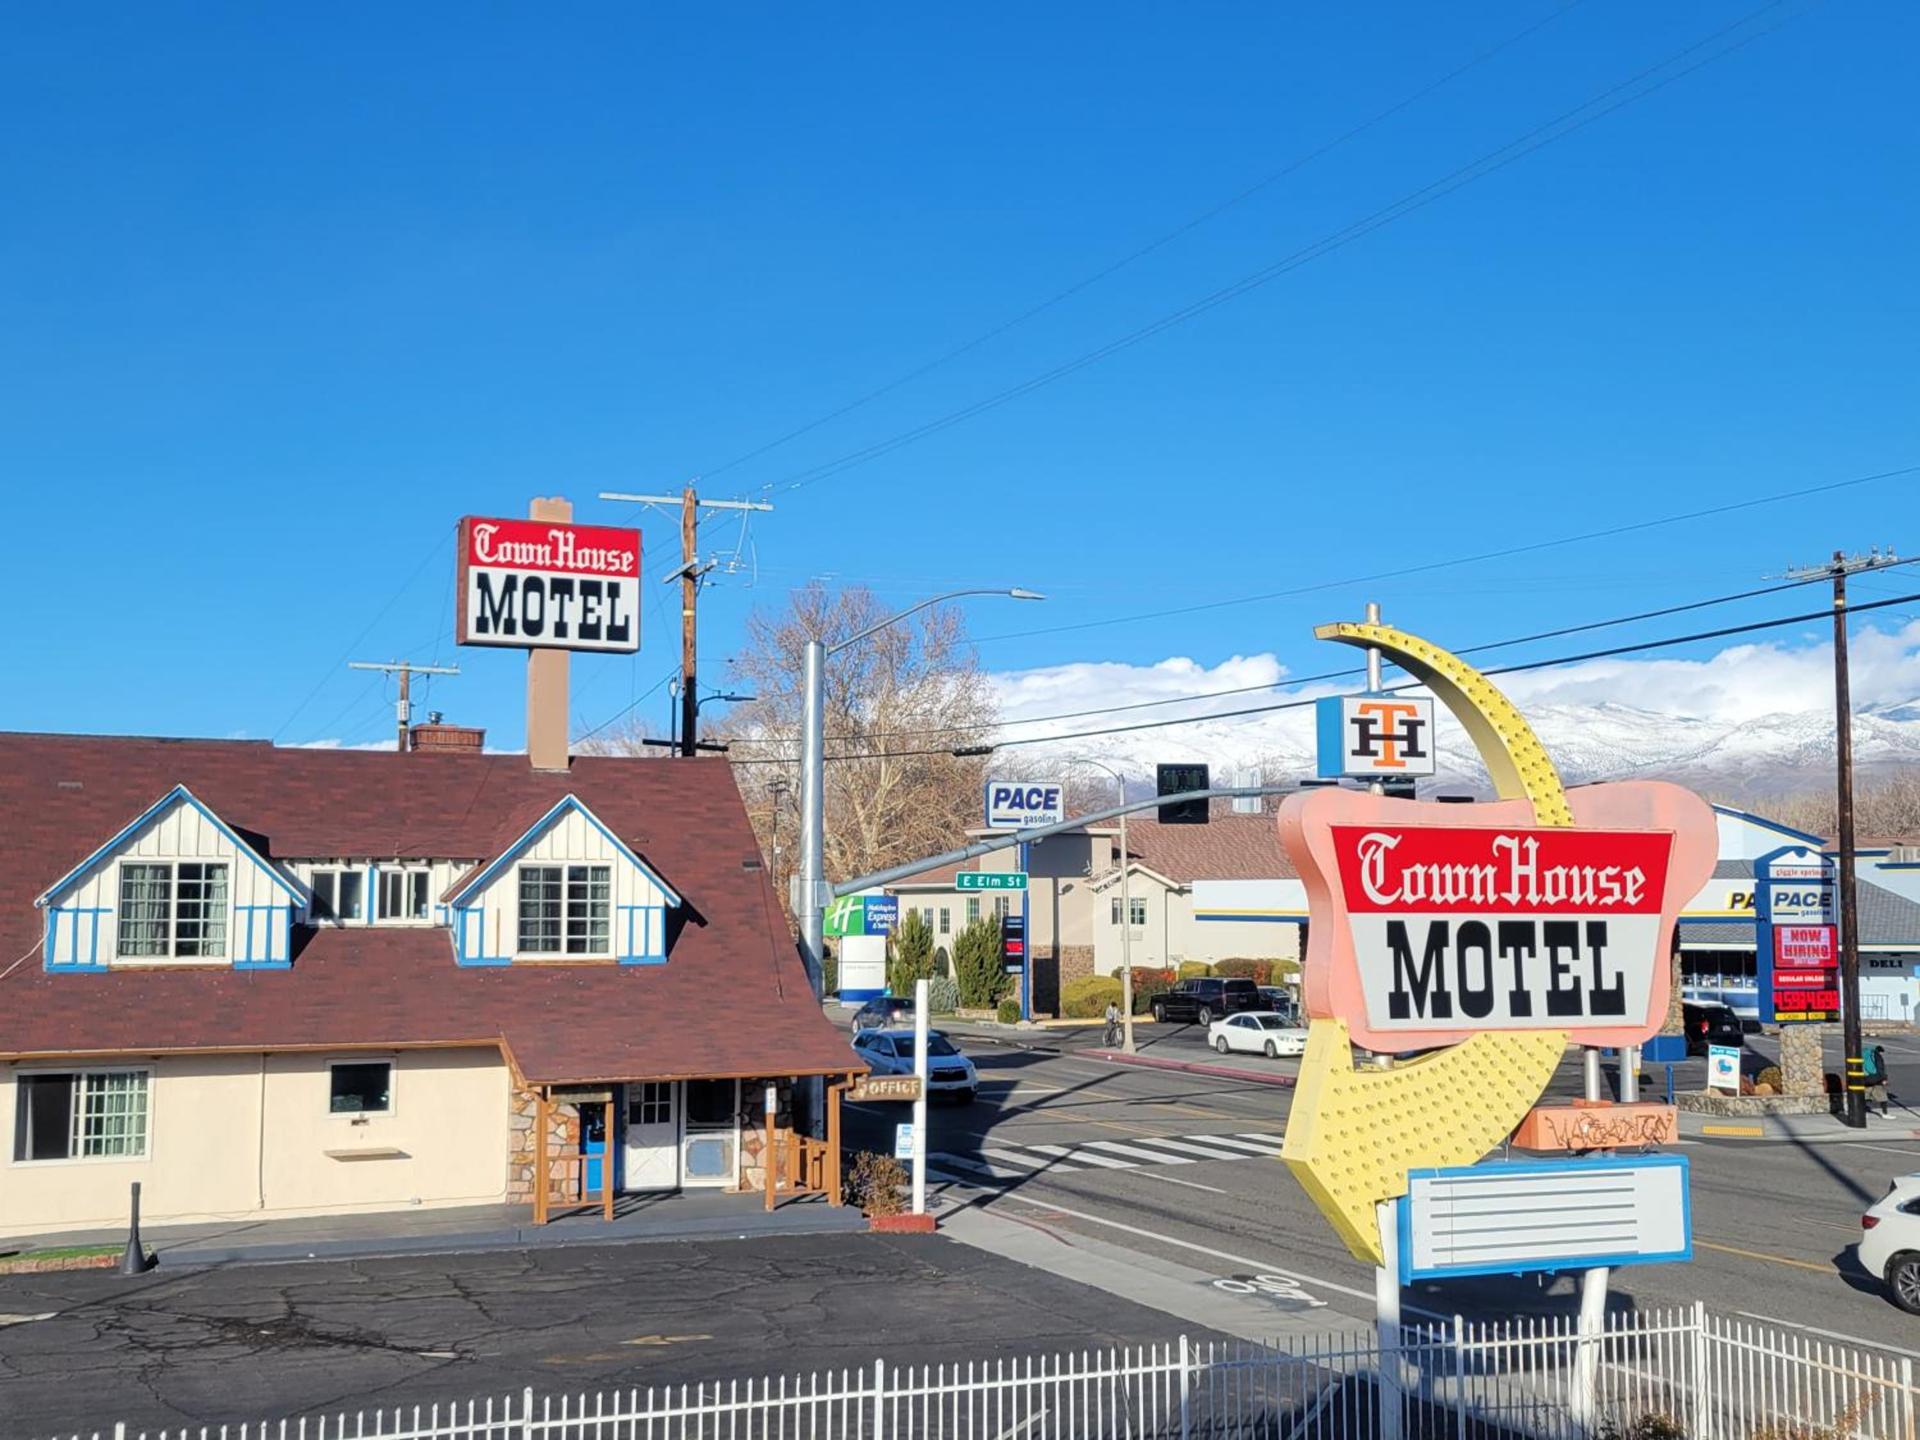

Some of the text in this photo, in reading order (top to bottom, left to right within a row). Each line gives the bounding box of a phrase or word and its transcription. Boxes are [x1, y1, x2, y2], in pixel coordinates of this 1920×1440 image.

[475, 572, 630, 642] MOTEL
[993, 787, 1060, 810] PACE
[1023, 814, 1057, 825] gasoline
[963, 876, 1022, 886] E Elm St
[1774, 892, 1832, 907] PACE
[867, 912, 897, 921] Express
[1790, 930, 1821, 942] NOW
[1784, 944, 1829, 957] HIRING
[1386, 920, 1627, 1019] MOTEL
[1869, 959, 1903, 968] DELI
